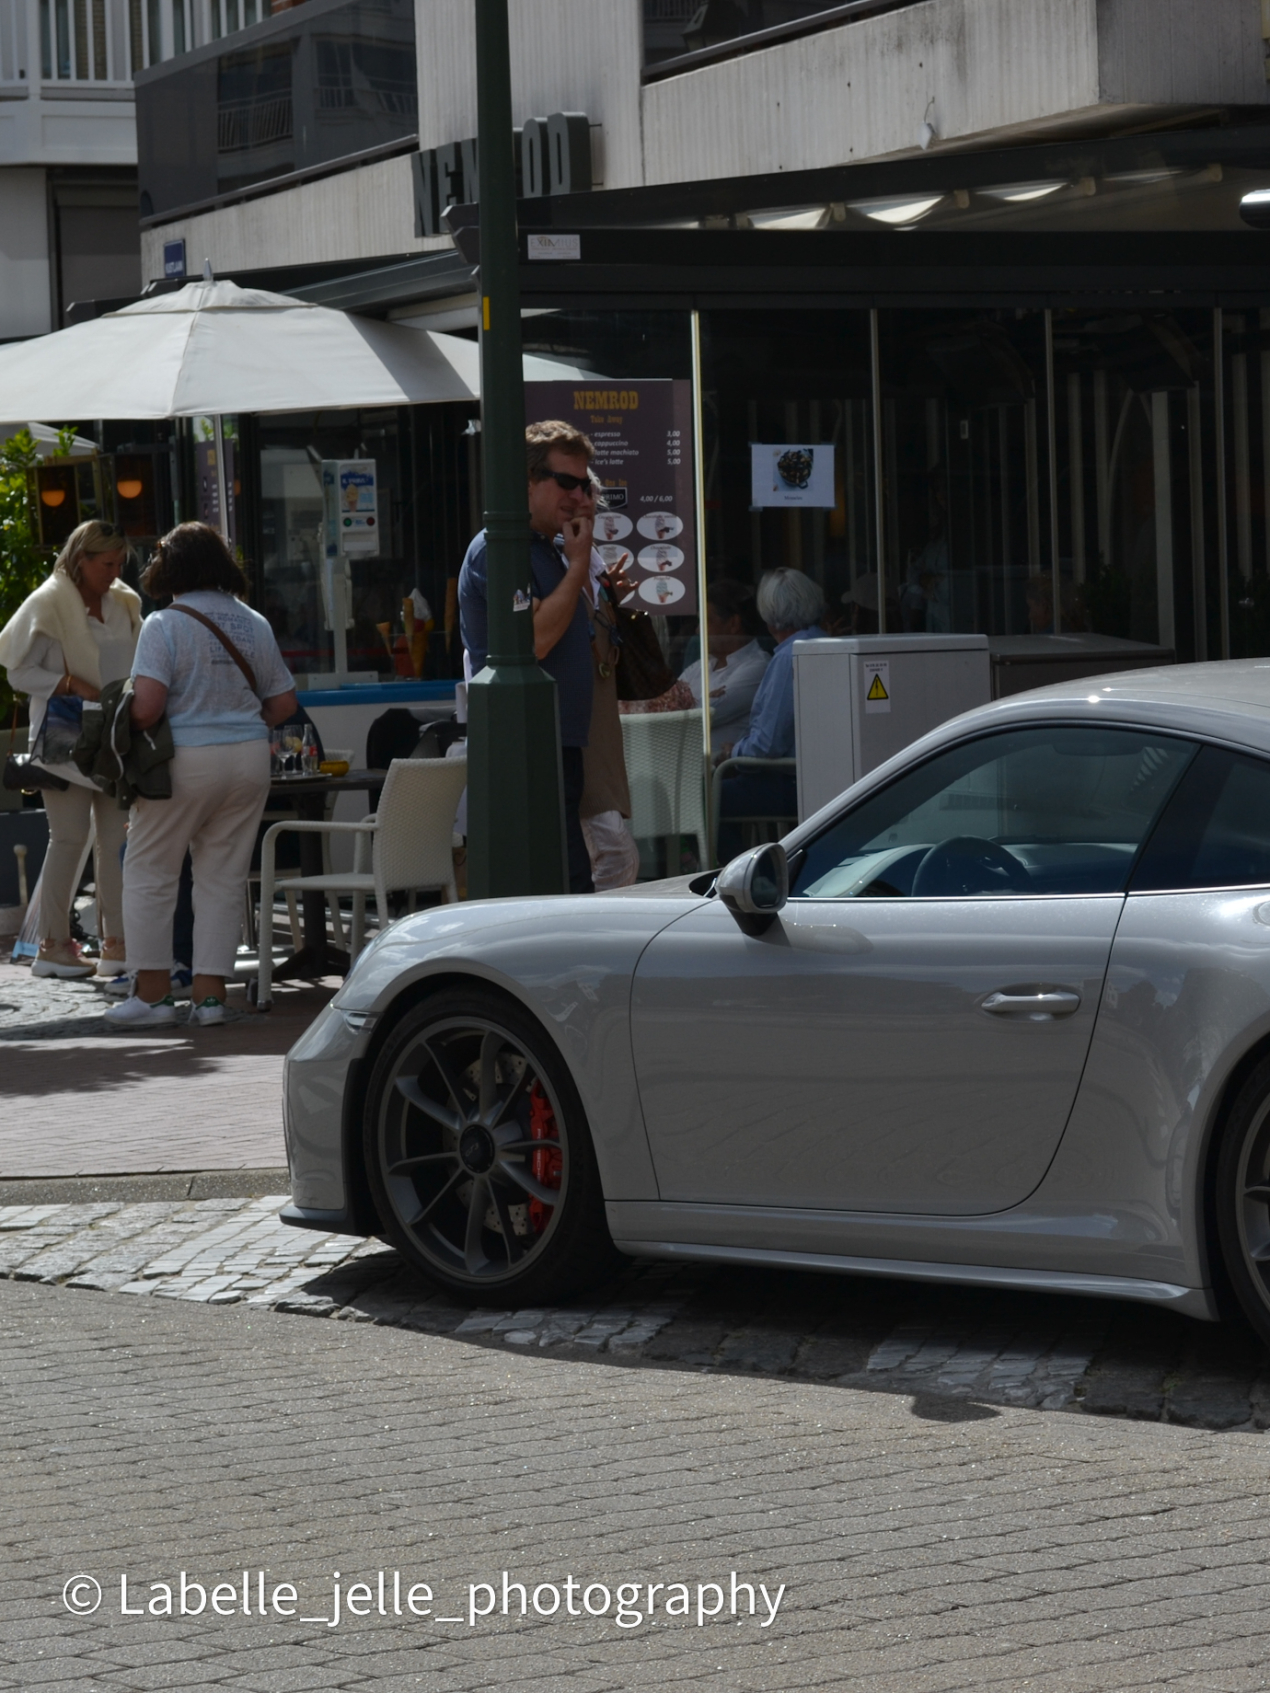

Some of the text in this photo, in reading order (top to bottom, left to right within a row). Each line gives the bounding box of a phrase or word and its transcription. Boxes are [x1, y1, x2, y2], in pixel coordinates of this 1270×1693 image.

[573, 391, 639, 411] NEMROD
[594, 431, 621, 439] espresso
[594, 440, 629, 448] cappuccino
[594, 448, 610, 456] latte
[666, 448, 681, 456] 5,00
[609, 458, 624, 466] latte
[667, 458, 681, 466] 5,00
